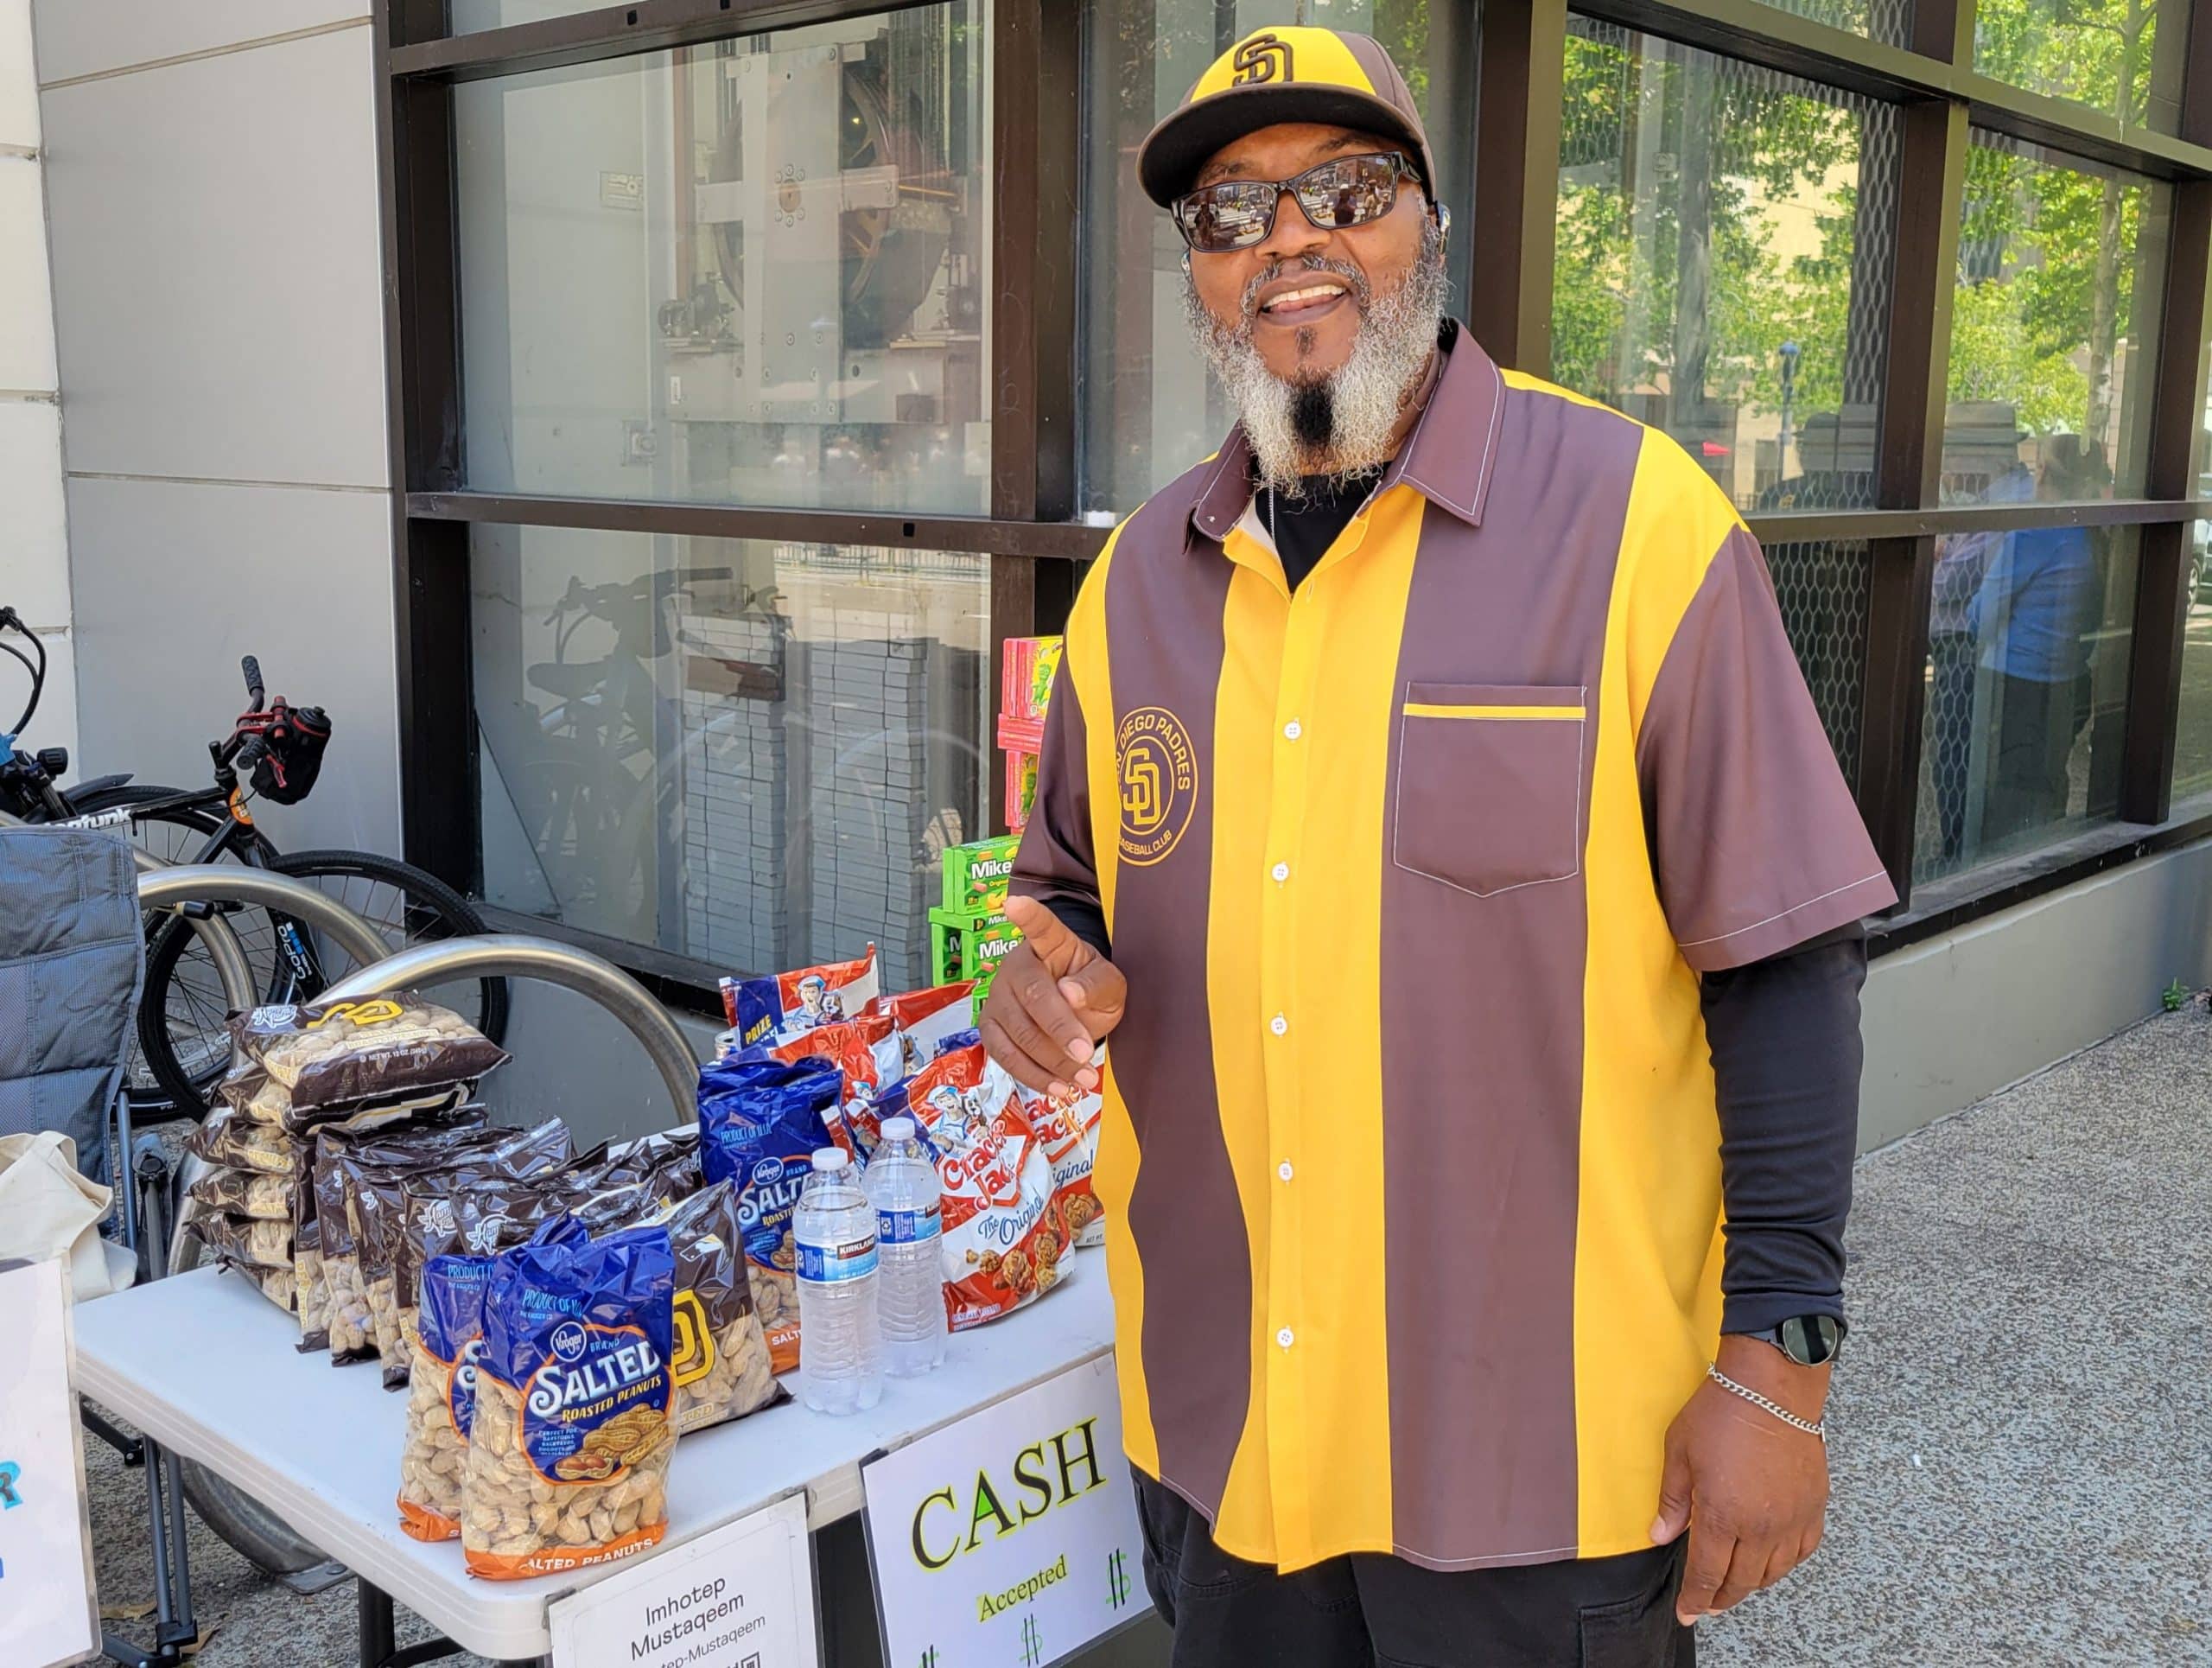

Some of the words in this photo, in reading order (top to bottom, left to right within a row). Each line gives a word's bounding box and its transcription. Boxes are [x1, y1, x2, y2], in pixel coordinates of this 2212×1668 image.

[1121, 714, 1155, 749] DIEGO
[1154, 717, 1191, 790] PADRES
[1124, 748, 1161, 825] SD
[1153, 829, 1173, 852] CLUB
[971, 859, 1012, 880] Mike
[745, 1014, 772, 1045] PRIZE
[756, 1163, 780, 1181] Kroger
[786, 1164, 808, 1176] BRAND
[978, 1214, 1000, 1239] The
[1000, 1187, 1044, 1245] Original
[448, 1264, 484, 1281] PRODUCT
[522, 1288, 557, 1312] PRODUCT
[558, 1298, 570, 1313] OF
[555, 1329, 582, 1355] Kroger
[589, 1337, 620, 1353] BRAND
[528, 1340, 661, 1418] SALTED
[562, 1398, 614, 1423] ROASTED
[617, 1374, 662, 1404] PEANUTS
[912, 1417, 1107, 1569] CASH
[582, 1538, 653, 1566] PEANUTS
[645, 1577, 726, 1627] Imhotep
[979, 1555, 1068, 1622] Accepted
[630, 1594, 745, 1661] Mustaqeem
